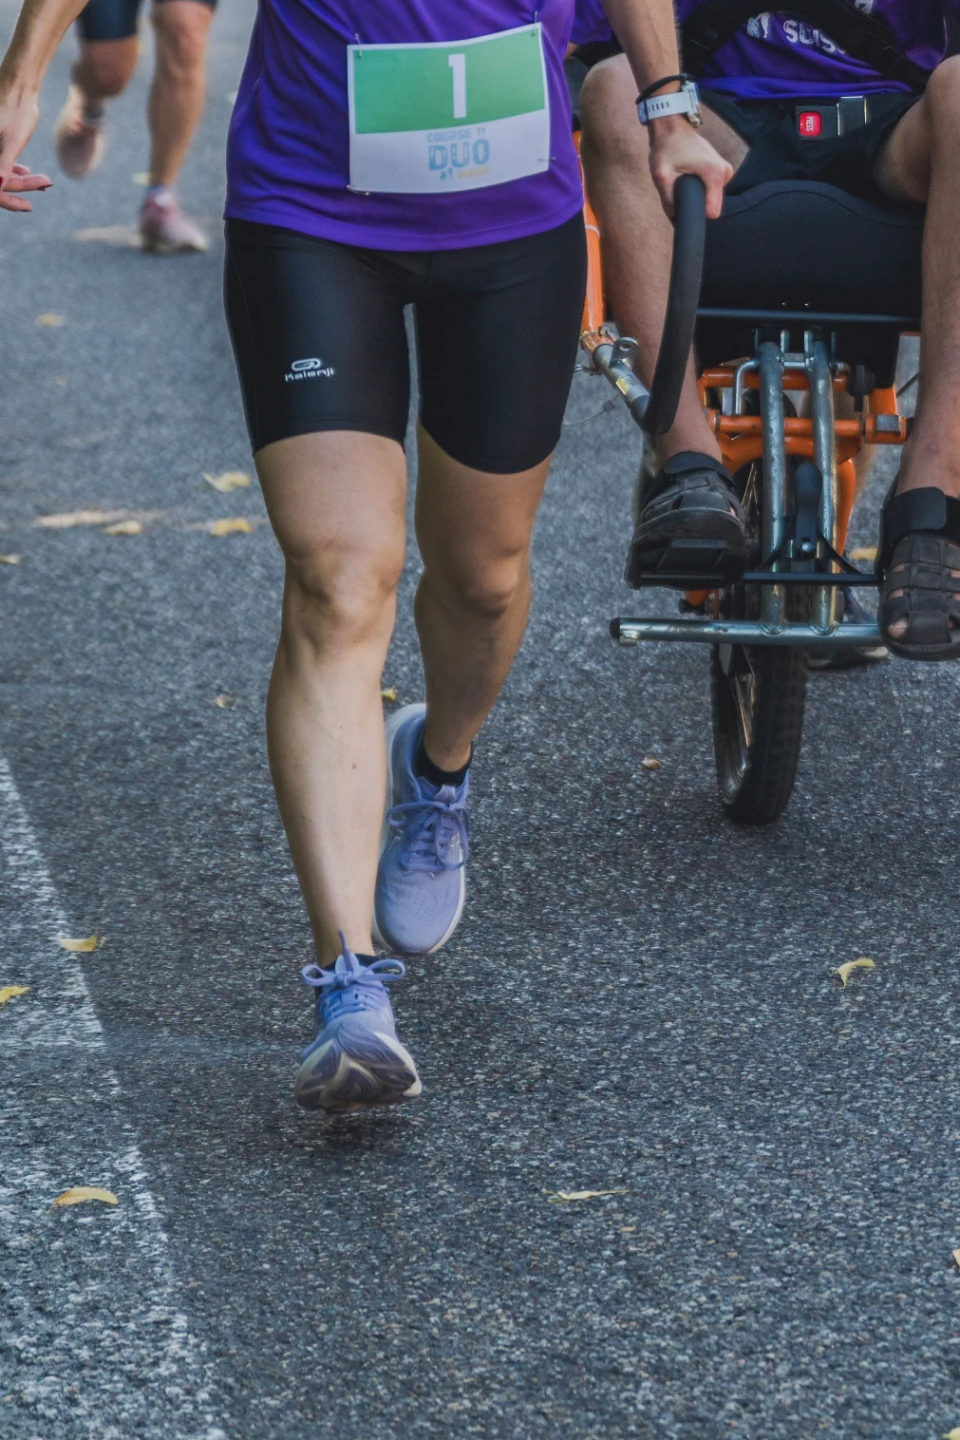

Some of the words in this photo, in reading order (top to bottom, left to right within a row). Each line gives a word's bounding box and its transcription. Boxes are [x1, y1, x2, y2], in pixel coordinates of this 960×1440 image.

[448, 53, 467, 119] 1
[427, 129, 472, 142] COURSE
[428, 138, 490, 171] DUO
[284, 367, 334, 381] Kalenji
